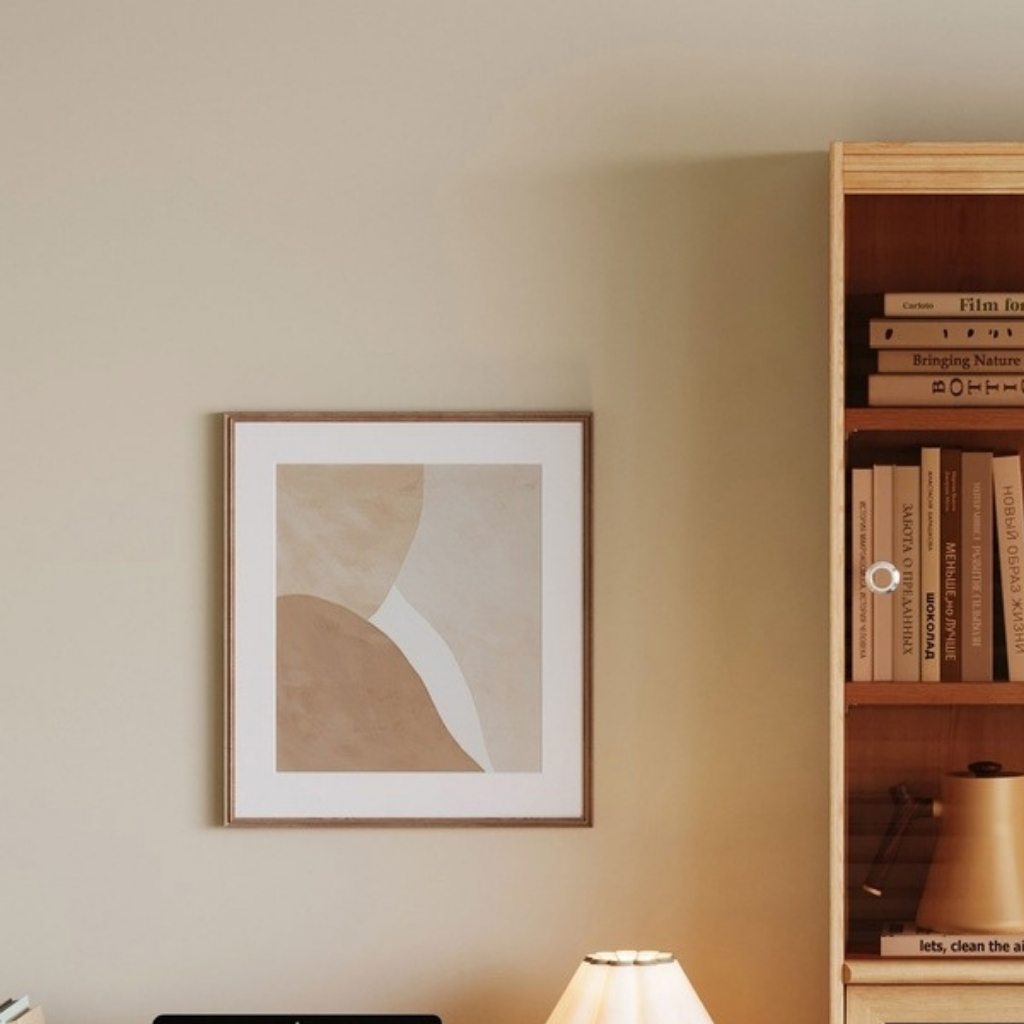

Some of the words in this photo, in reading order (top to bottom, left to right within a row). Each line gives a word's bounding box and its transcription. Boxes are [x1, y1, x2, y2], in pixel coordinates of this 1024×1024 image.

[959, 297, 999, 312] Film
[912, 353, 971, 369] Bringing
[974, 354, 1021, 366] Nature
[902, 503, 914, 553] ЗАБОТА
[1002, 485, 1019, 540] НОВЫЙ
[902, 558, 913, 568] О
[1007, 545, 1021, 594] ОБРАЗ
[902, 571, 914, 656] ПРЕДАННЫХ
[925, 592, 935, 660] ШОКОЛАД
[944, 617, 957, 661] ЛУЧШЕ
[919, 940, 947, 954] lets,
[950, 940, 985, 952] clean
[988, 940, 1010, 952] the
